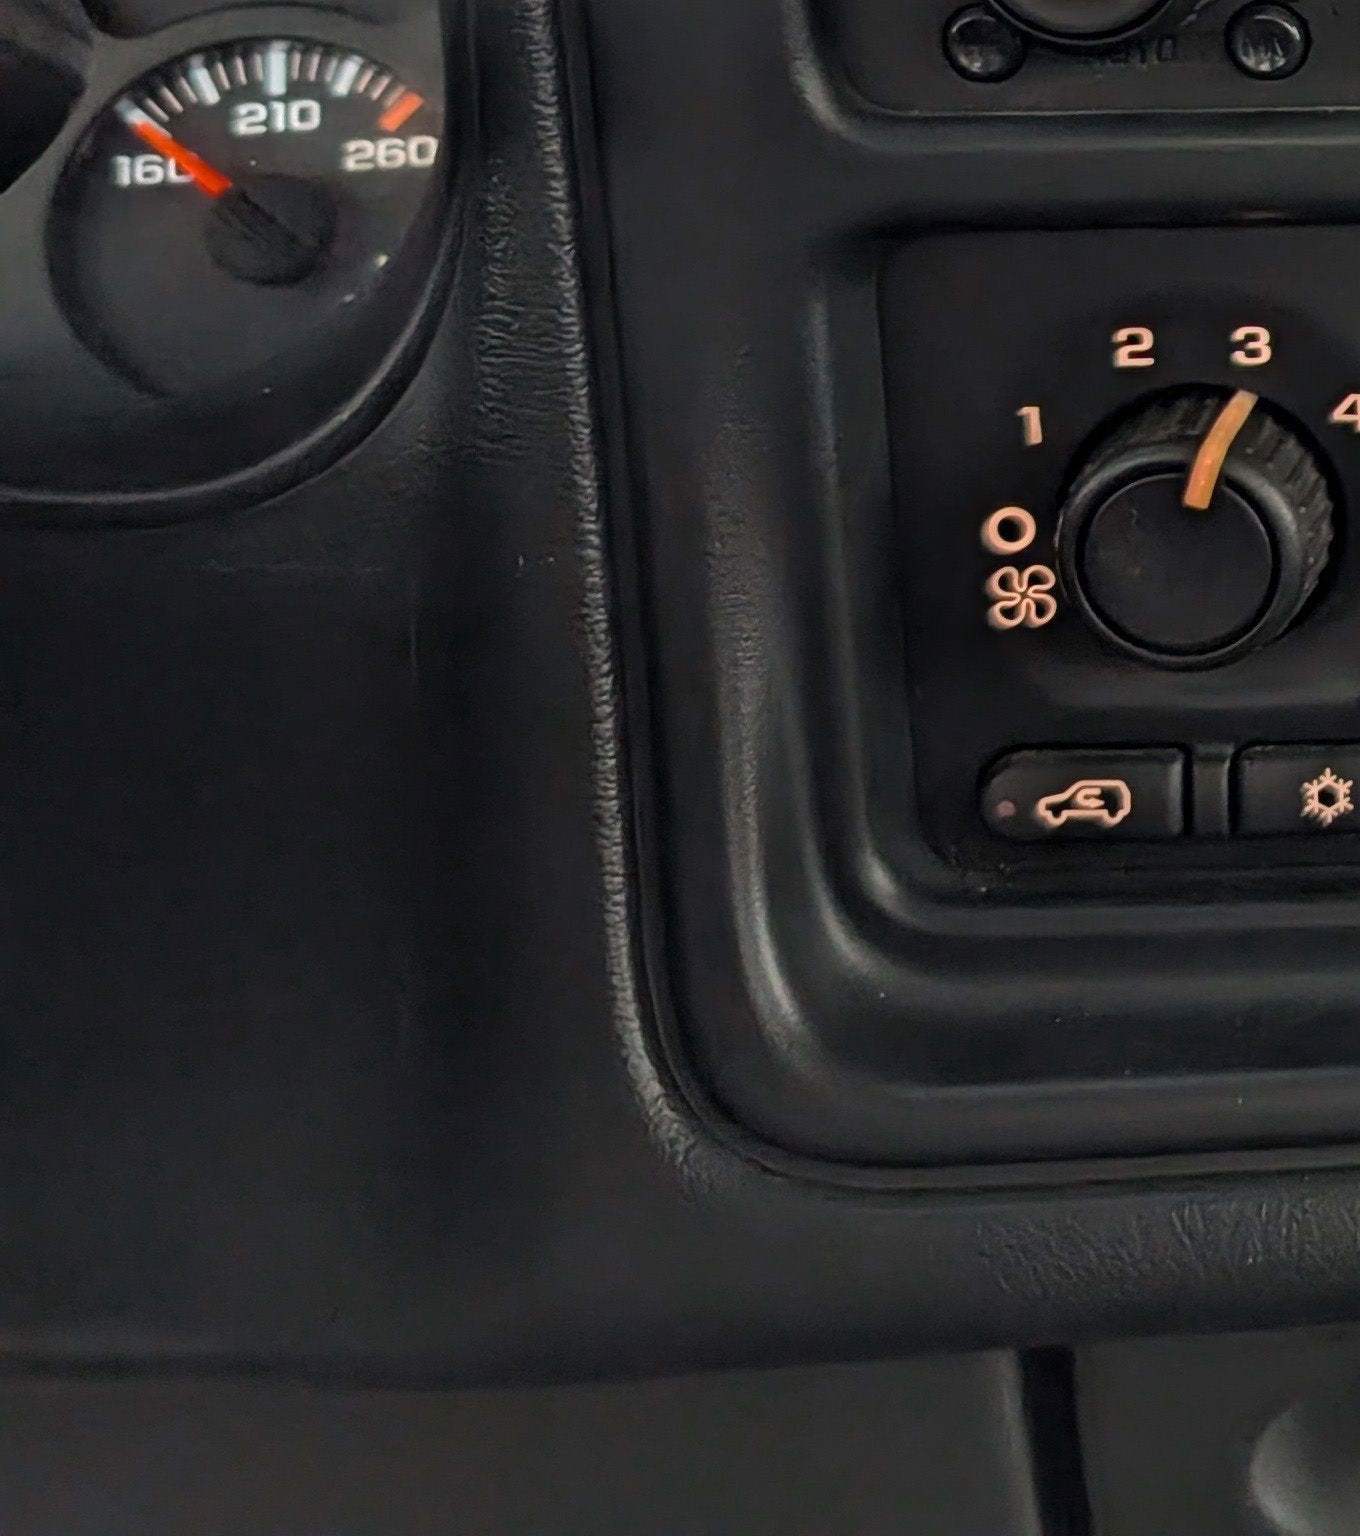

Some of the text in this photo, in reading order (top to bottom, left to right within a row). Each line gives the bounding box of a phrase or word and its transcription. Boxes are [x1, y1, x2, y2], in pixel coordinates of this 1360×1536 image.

[233, 99, 321, 136] 210
[344, 138, 439, 172] 260
[1112, 326, 1155, 368] 2
[1231, 325, 1272, 366] 3
[1017, 406, 1043, 446] 1
